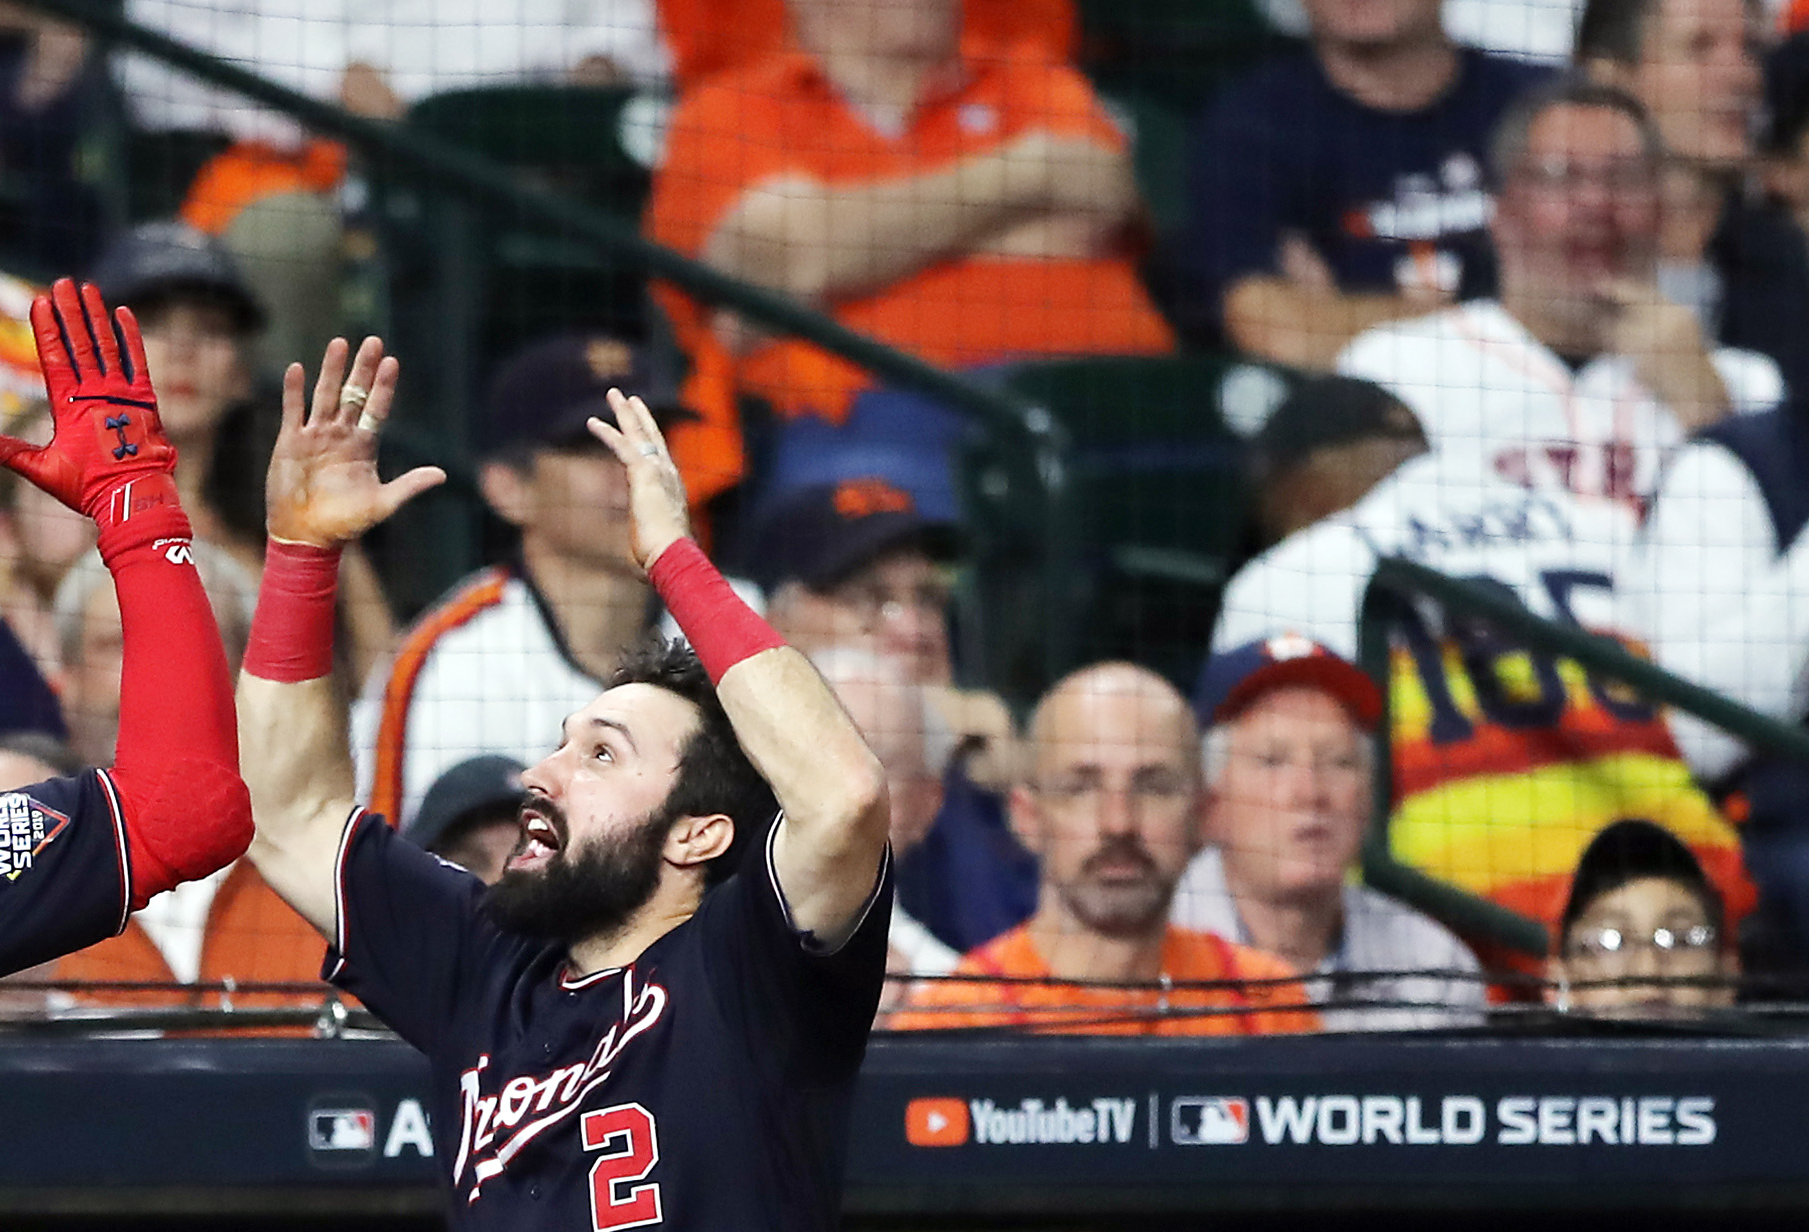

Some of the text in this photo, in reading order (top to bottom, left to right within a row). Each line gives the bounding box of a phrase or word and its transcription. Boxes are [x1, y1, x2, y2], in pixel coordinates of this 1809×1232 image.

[9, 793, 32, 869] SERIES
[1256, 1096, 1718, 1145] WORLD SERIES
